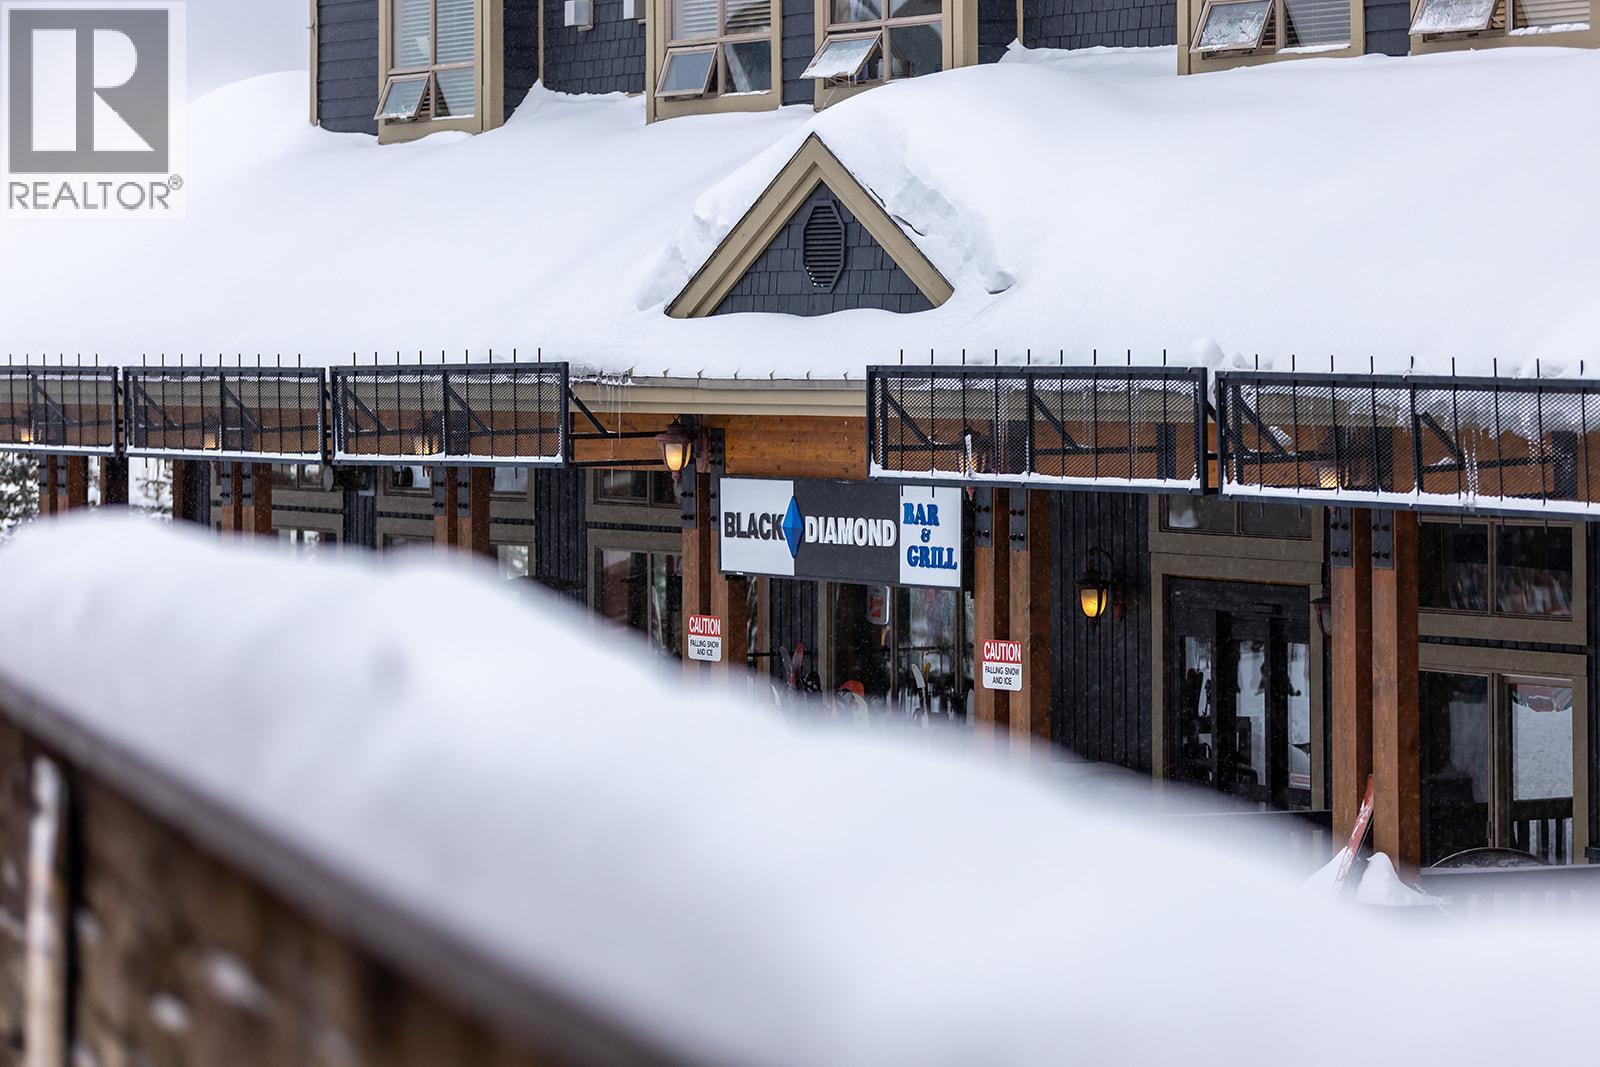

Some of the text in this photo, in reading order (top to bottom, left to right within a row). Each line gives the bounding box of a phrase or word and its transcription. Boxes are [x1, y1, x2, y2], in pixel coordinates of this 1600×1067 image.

[902, 502, 940, 526] BAR
[724, 511, 898, 547] BLACK DIAMOND
[920, 528, 931, 543] &
[906, 545, 957, 570] GRILL
[689, 616, 721, 635] CAUTION
[690, 639, 706, 647] FALLING
[983, 641, 1021, 662] CAUTION
[697, 648, 705, 656] AND
[985, 665, 1019, 675] FALLING SNOW
[992, 676, 1012, 685] AND ICE
